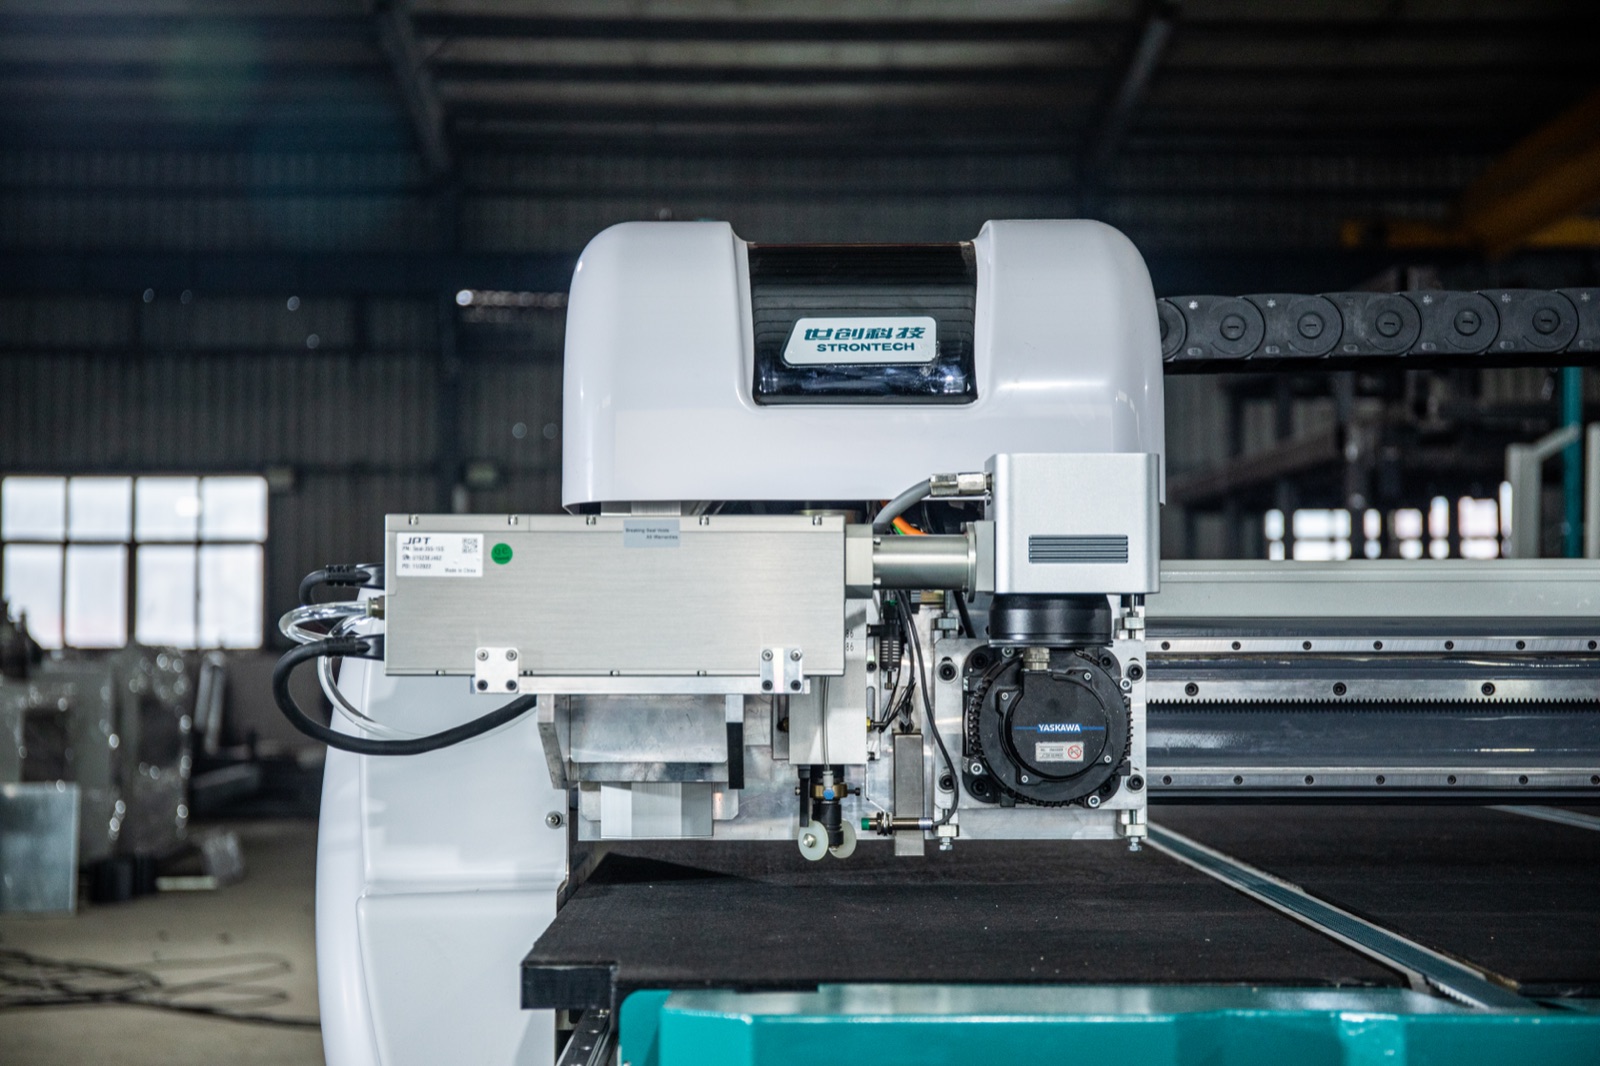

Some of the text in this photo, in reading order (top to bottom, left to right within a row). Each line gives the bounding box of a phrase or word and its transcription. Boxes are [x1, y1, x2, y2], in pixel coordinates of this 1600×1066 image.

[804, 327, 926, 341] 世创科技
[816, 342, 915, 352] STRONTECH
[402, 537, 431, 545] JPT
[1038, 723, 1081, 732] YASKAWA
